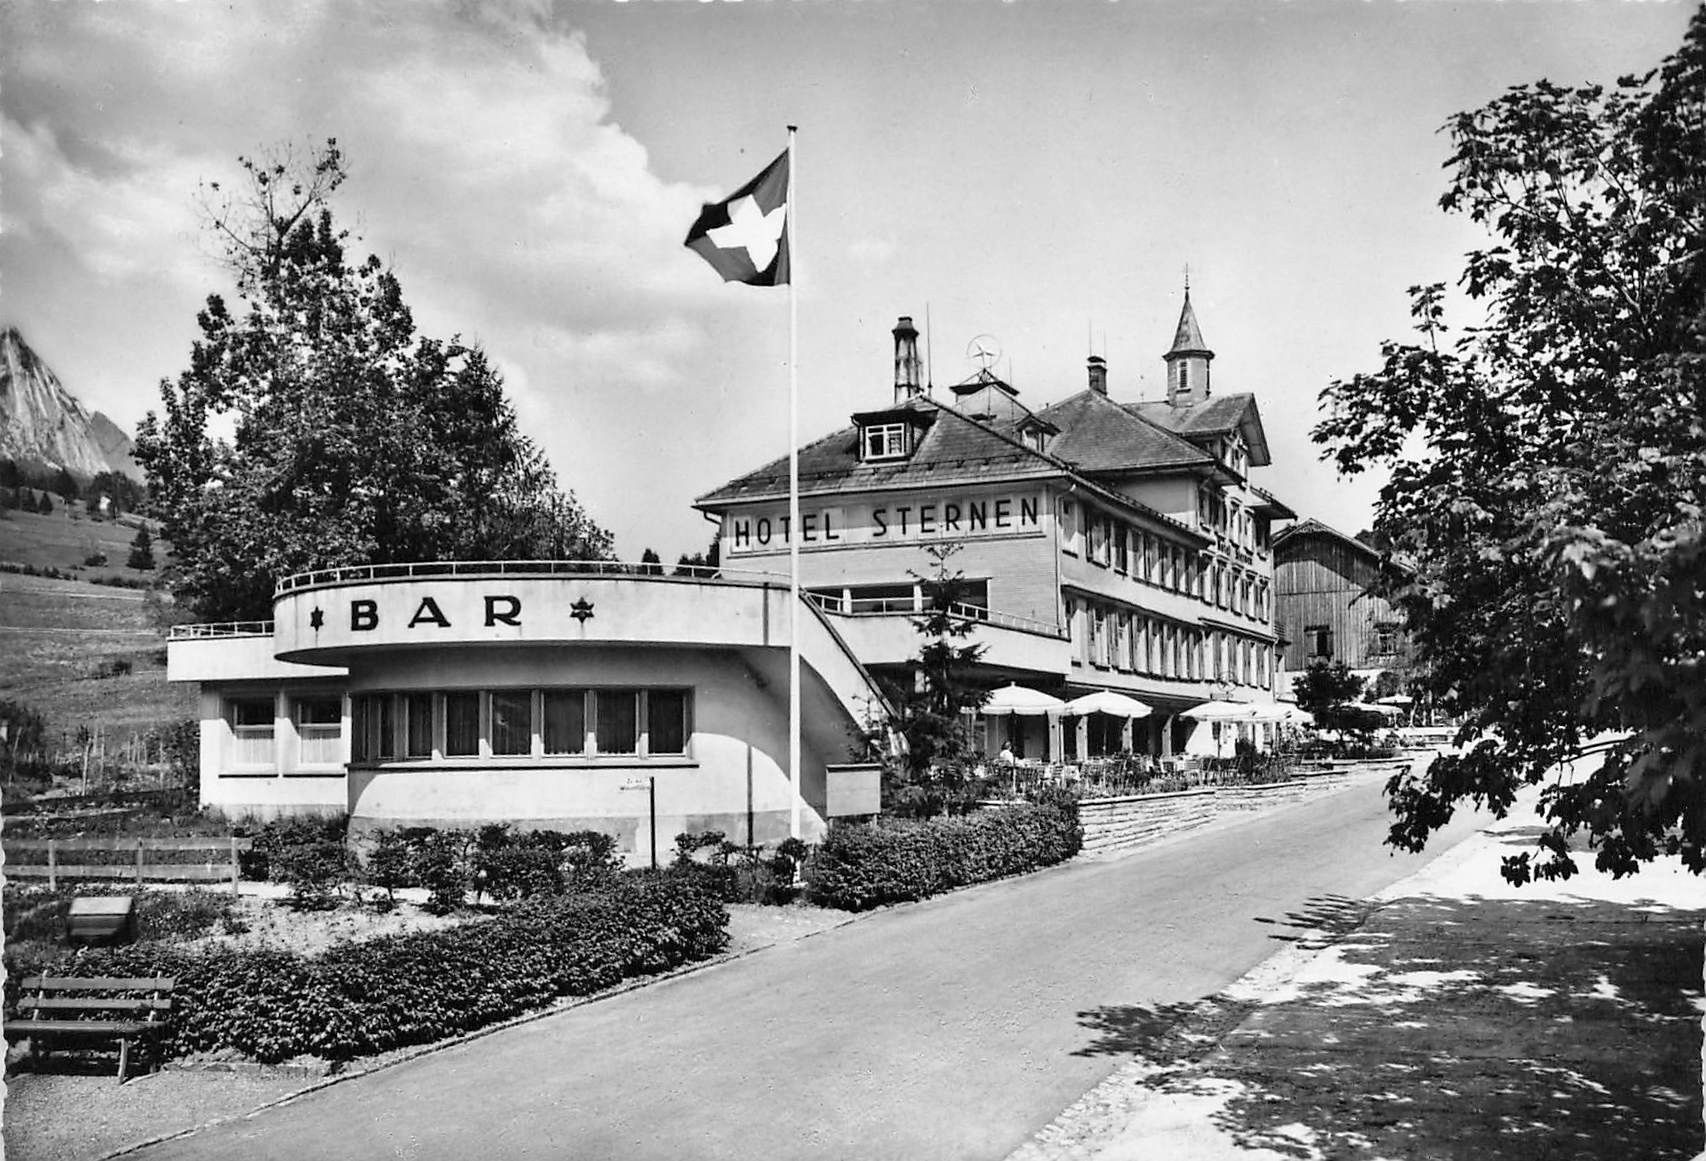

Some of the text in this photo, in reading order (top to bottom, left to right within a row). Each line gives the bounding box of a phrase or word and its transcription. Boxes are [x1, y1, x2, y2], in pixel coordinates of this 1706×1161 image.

[735, 497, 1039, 547] HOTEL STERNEN
[350, 595, 522, 632] BAR
